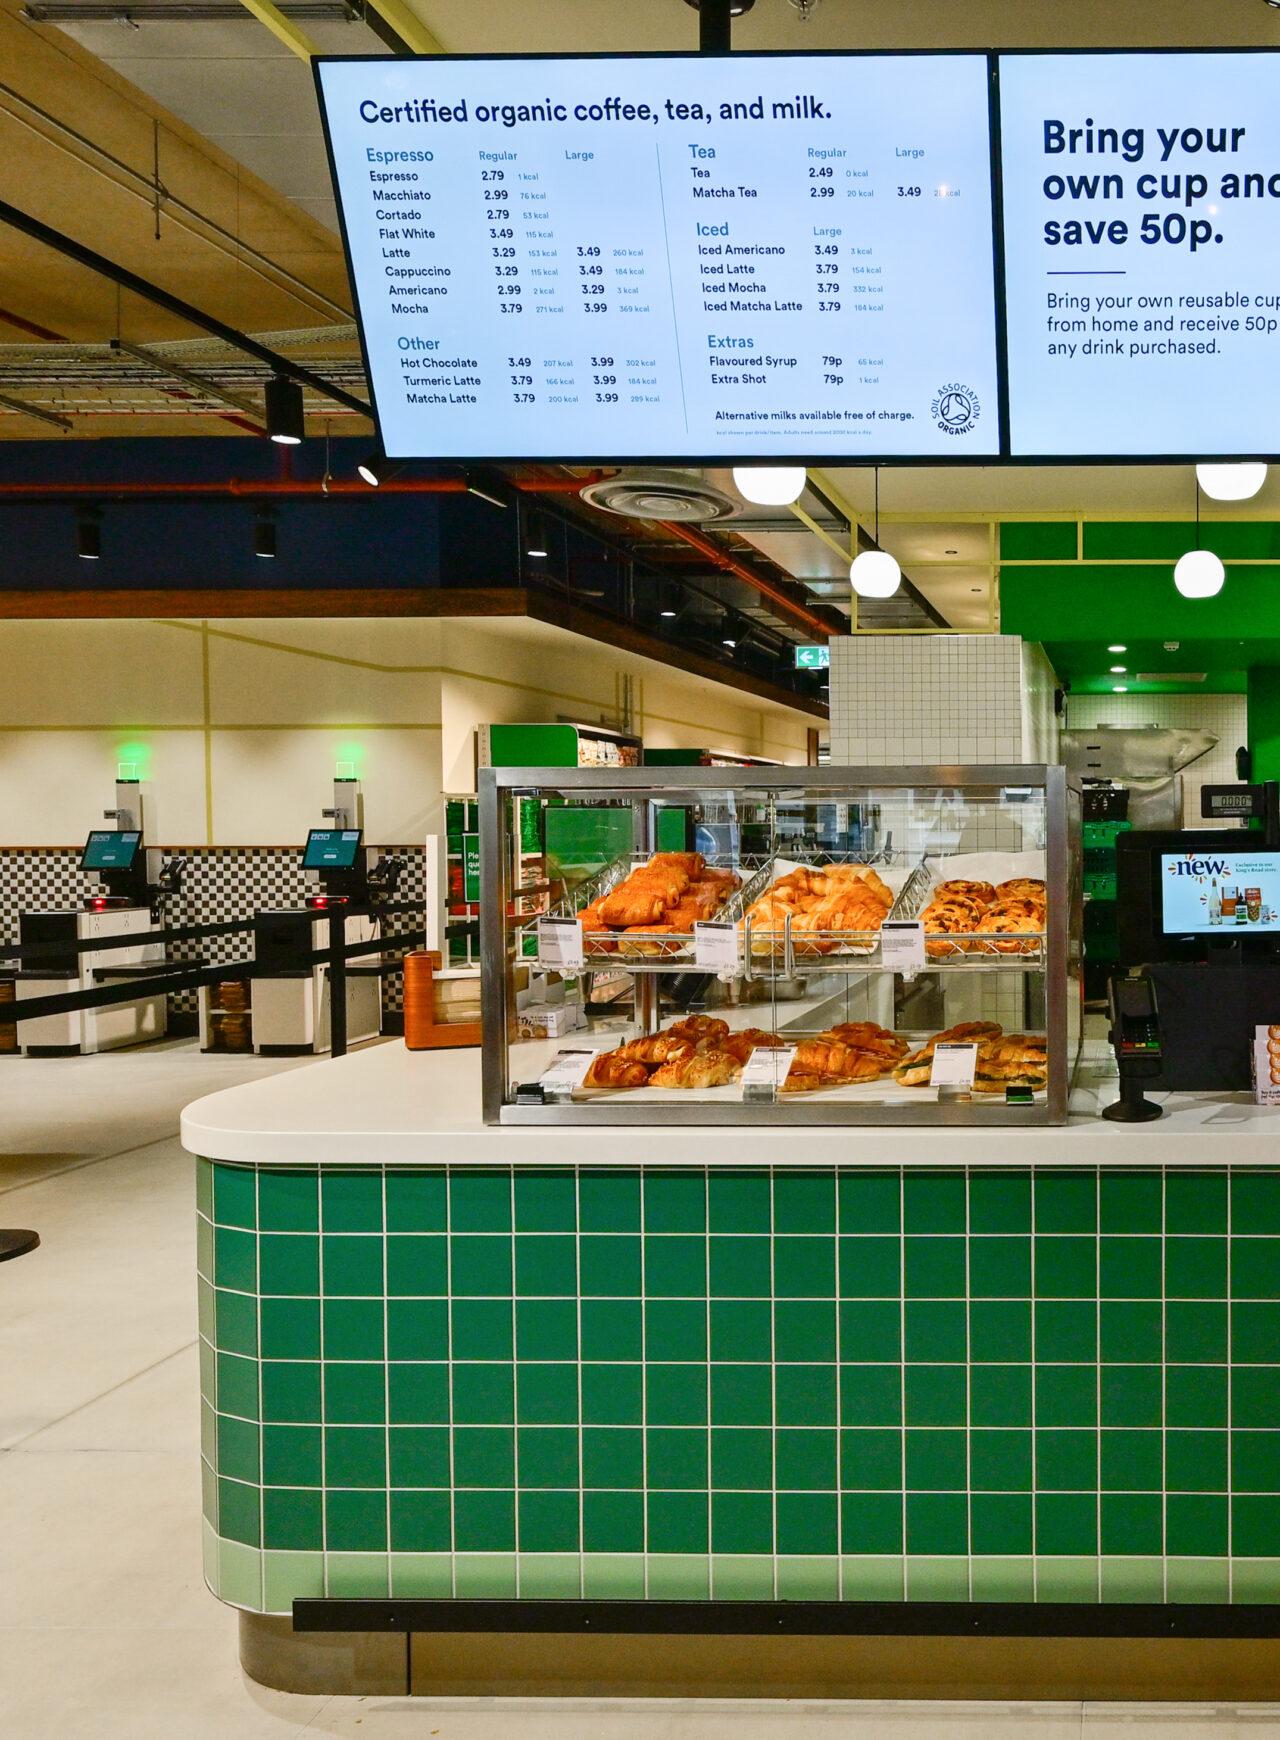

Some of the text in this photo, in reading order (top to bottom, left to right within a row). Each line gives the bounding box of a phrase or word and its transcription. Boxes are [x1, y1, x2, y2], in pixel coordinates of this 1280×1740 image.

[360, 95, 831, 127] Certified organic coffee, tea, and milk.
[1044, 118, 1245, 162] Bring your
[366, 148, 594, 165] Espresso Regular Large
[688, 144, 715, 158] Tea
[808, 147, 924, 159] Regular Large
[370, 171, 504, 184] Espresso 2.79
[691, 167, 833, 177] Tea 2.49
[373, 190, 508, 200] Macchiato 2.99
[693, 187, 735, 197] Matcha
[738, 187, 757, 197] Tea
[811, 187, 834, 197] 2.99
[898, 187, 921, 196] 3.49
[1043, 175, 1123, 200] own
[1137, 174, 1207, 207] cup
[376, 210, 509, 220] Cortado 2.79
[379, 228, 513, 239] Flat White 3.49
[697, 222, 842, 238] Iced Large
[1044, 213, 1223, 252] save 50p.
[382, 247, 600, 258] Latte 3.29 3.49
[699, 244, 838, 255] Iced Americano 3.49
[385, 266, 602, 279] Cappuccino 3.29 3.49
[701, 264, 838, 274] Iced Latte 3.79
[389, 285, 604, 295] Americano 2.99 3.29
[702, 282, 839, 292] Iced Mocha 3.79
[704, 301, 841, 311] Iced Matcha Latte 3.79
[1048, 293, 1089, 312] Bring
[1096, 297, 1132, 312] your
[1138, 297, 1172, 308] own
[1179, 291, 1249, 307] reusable
[392, 303, 607, 313] Mocha 3.79 3.99
[1047, 316, 1086, 332] from
[1093, 316, 1138, 331] home
[1144, 316, 1173, 331] and
[1181, 315, 1239, 331] receive
[1245, 316, 1277, 334] 50p
[398, 337, 439, 350] Other
[708, 335, 754, 348] Extras
[1048, 338, 1220, 358] any drink purchased.
[401, 357, 614, 368] Hot Chocolate 3.49 3.99
[710, 356, 842, 368] Flavoured Syrup 79p
[403, 376, 616, 385] Turmeric Latte 3.79 3.99
[712, 374, 843, 386] Extra Shot 79p
[407, 393, 618, 403] Matcha Latte 3.79 3.99
[931, 383, 981, 419] SOIL ASSOCIATION
[716, 411, 914, 421] Alternative milks available free of charge.
[938, 421, 975, 435] ORGANIC
[1177, 860, 1225, 876] new
